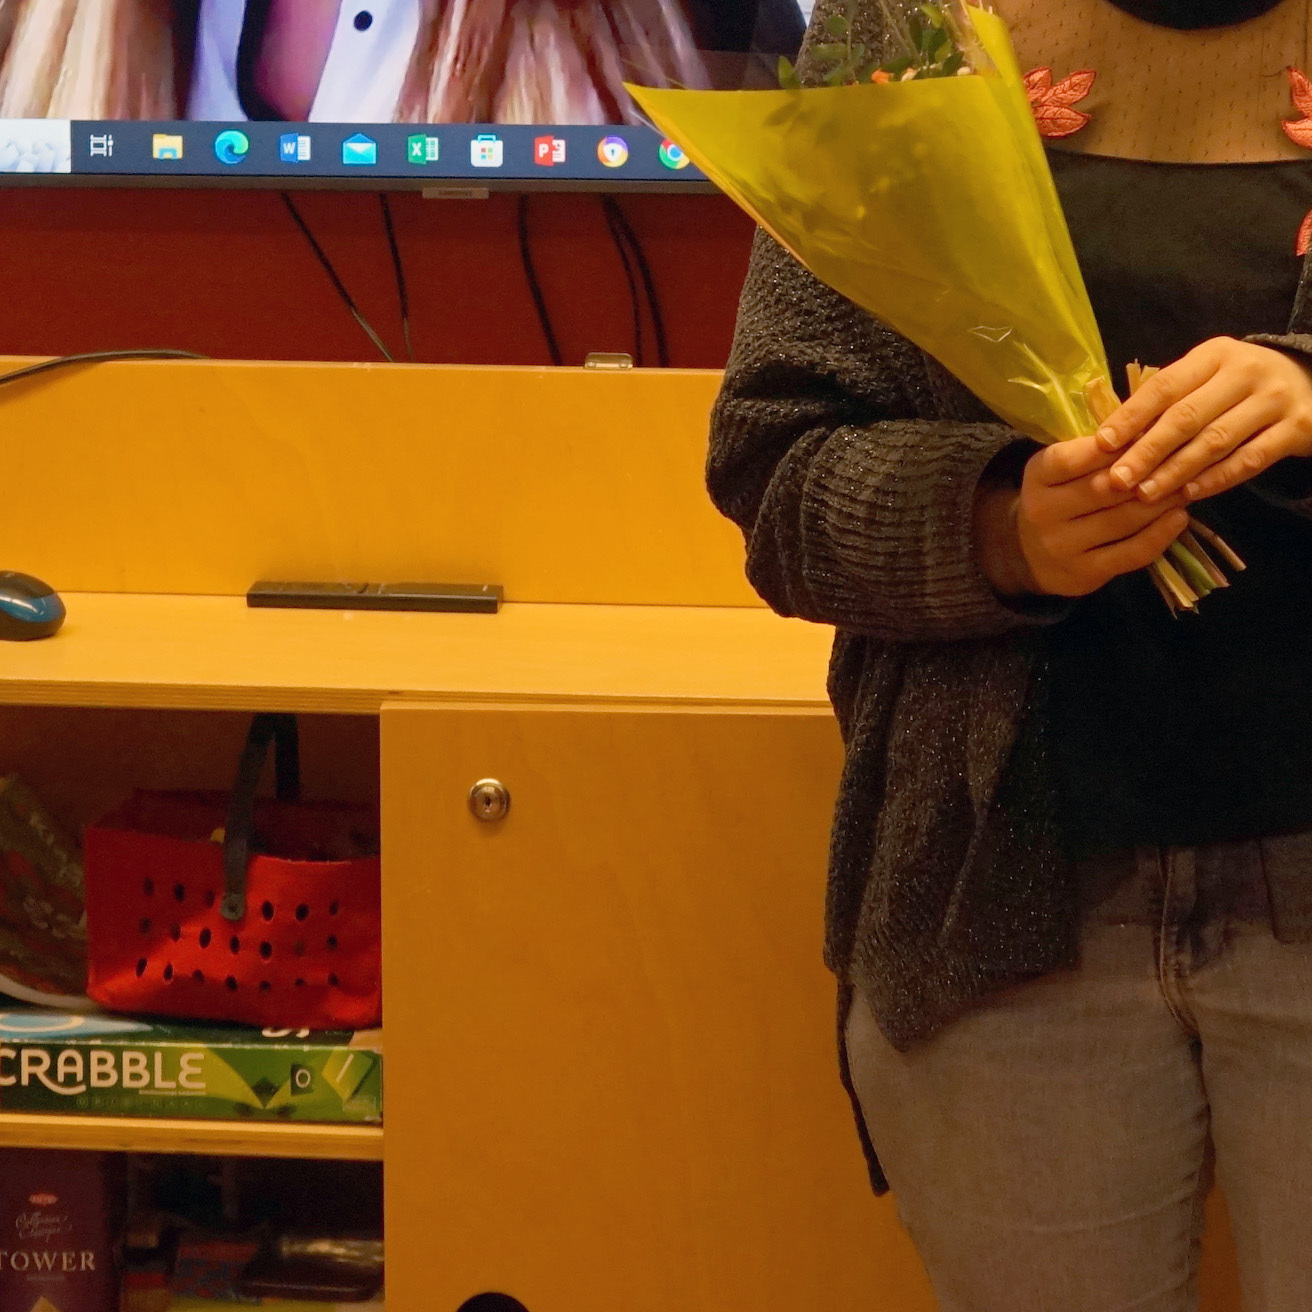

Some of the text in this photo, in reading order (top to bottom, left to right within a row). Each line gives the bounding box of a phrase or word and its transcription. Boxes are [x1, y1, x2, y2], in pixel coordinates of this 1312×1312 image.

[282, 141, 297, 155] W
[411, 142, 422, 157] X
[538, 143, 549, 158] P
